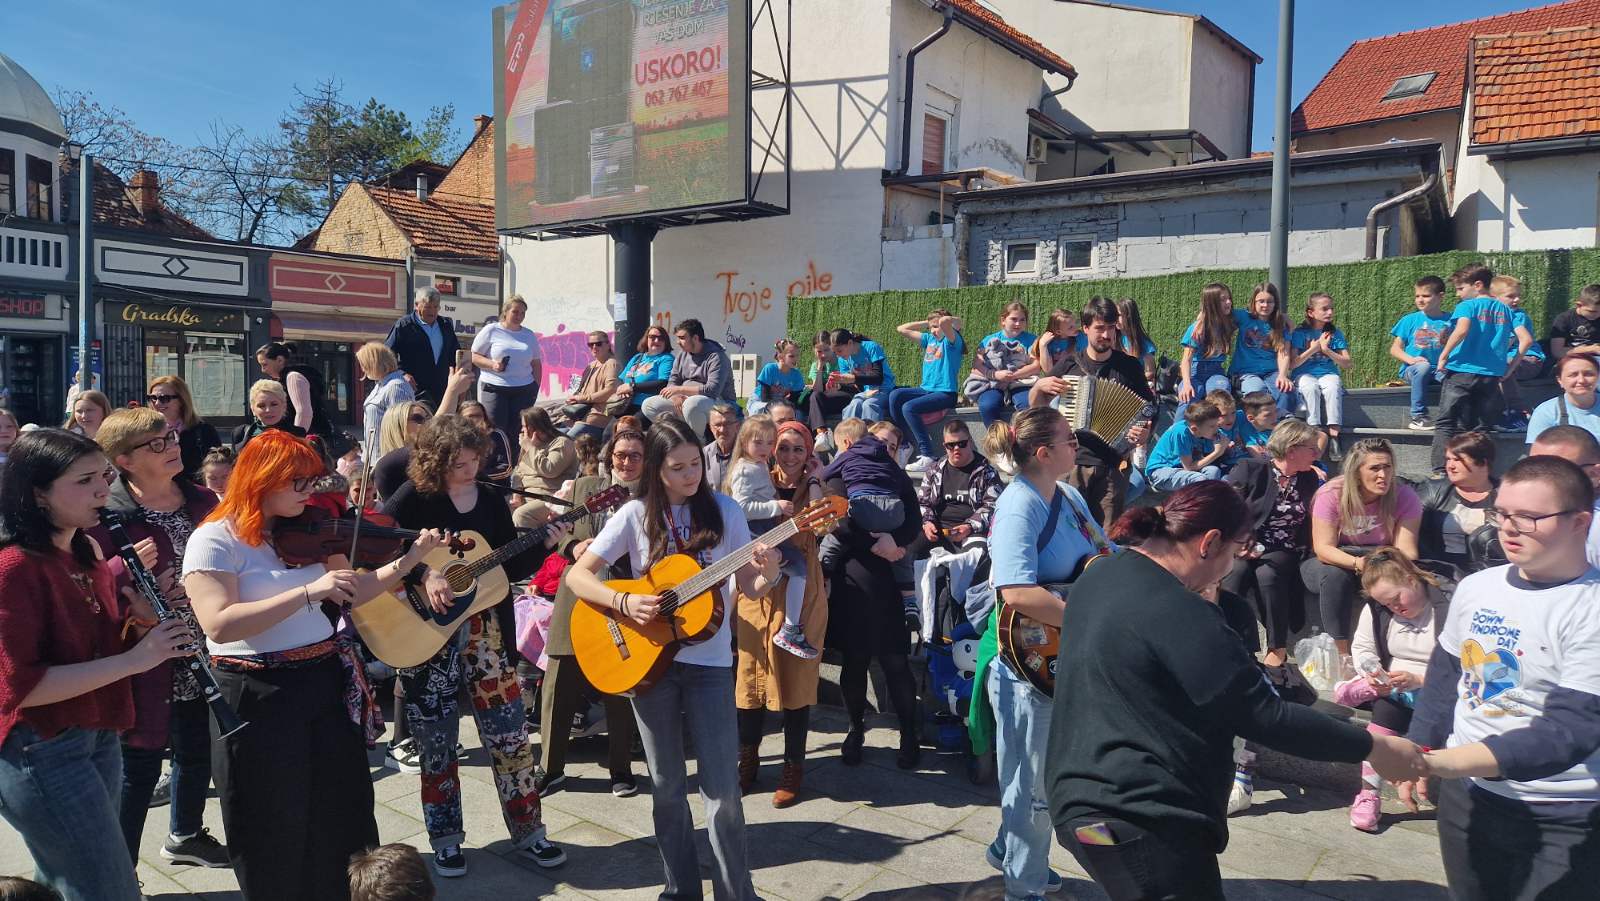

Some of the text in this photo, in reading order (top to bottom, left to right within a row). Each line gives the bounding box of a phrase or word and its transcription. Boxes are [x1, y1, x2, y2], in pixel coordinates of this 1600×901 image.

[635, 45, 721, 86] USKORO!
[716, 271, 772, 323] Tvoje
[122, 303, 202, 326] Gradska
[444, 304, 456, 312] bar
[1472, 611, 1505, 625] DOWN
[1496, 636, 1517, 650] DAY
